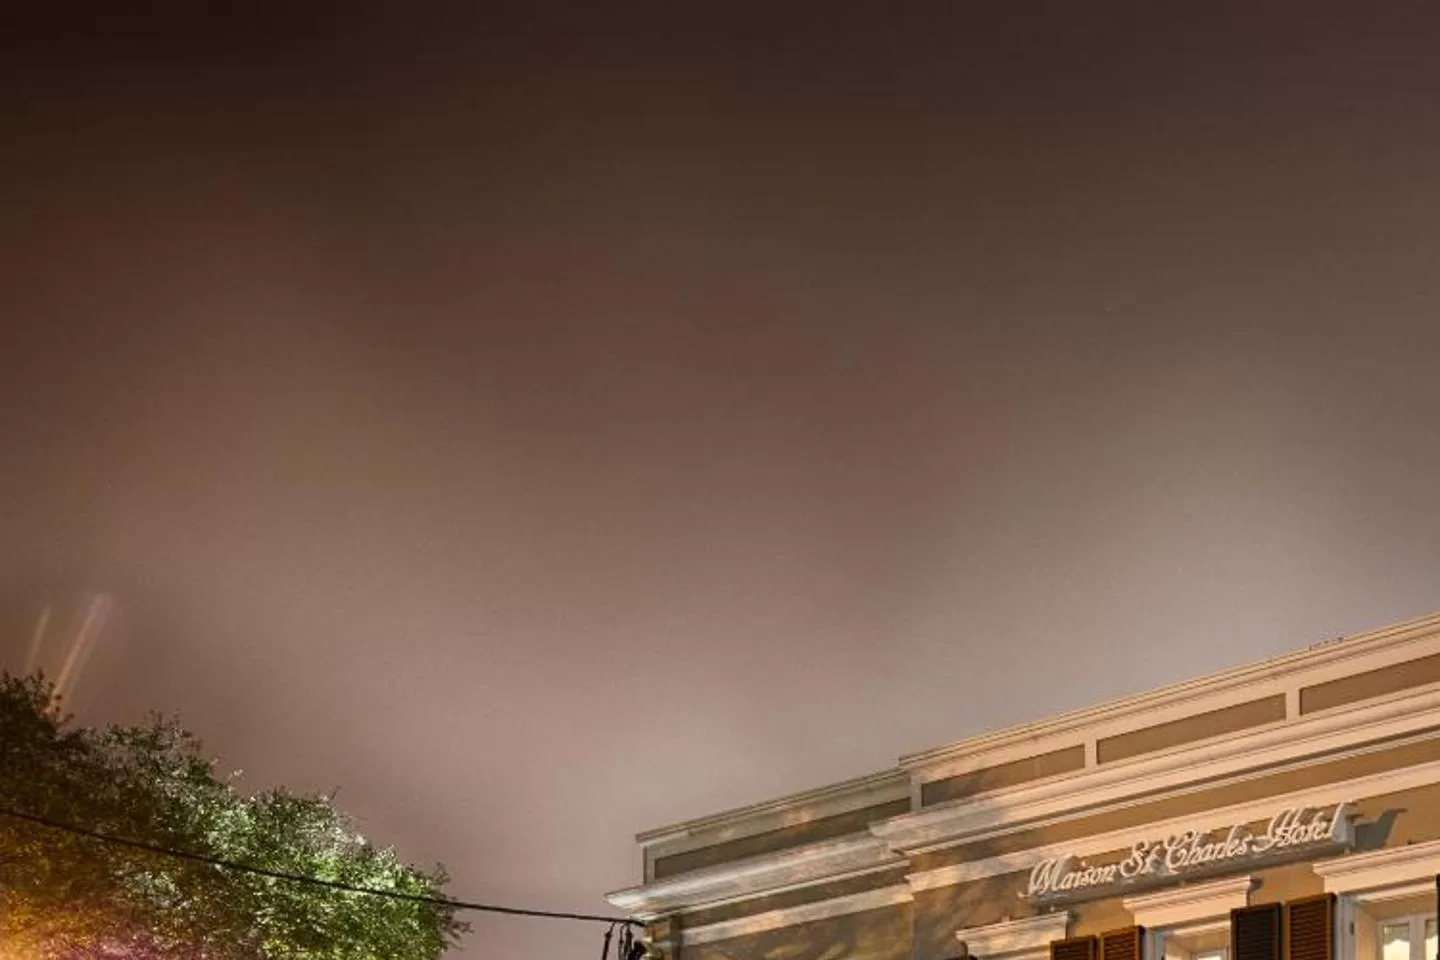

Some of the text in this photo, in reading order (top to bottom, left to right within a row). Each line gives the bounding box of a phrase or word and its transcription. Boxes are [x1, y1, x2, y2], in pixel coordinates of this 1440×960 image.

[1017, 854, 1119, 898] Maison
[1163, 828, 1250, 870] Charles
[1252, 800, 1347, 851] Hotel
